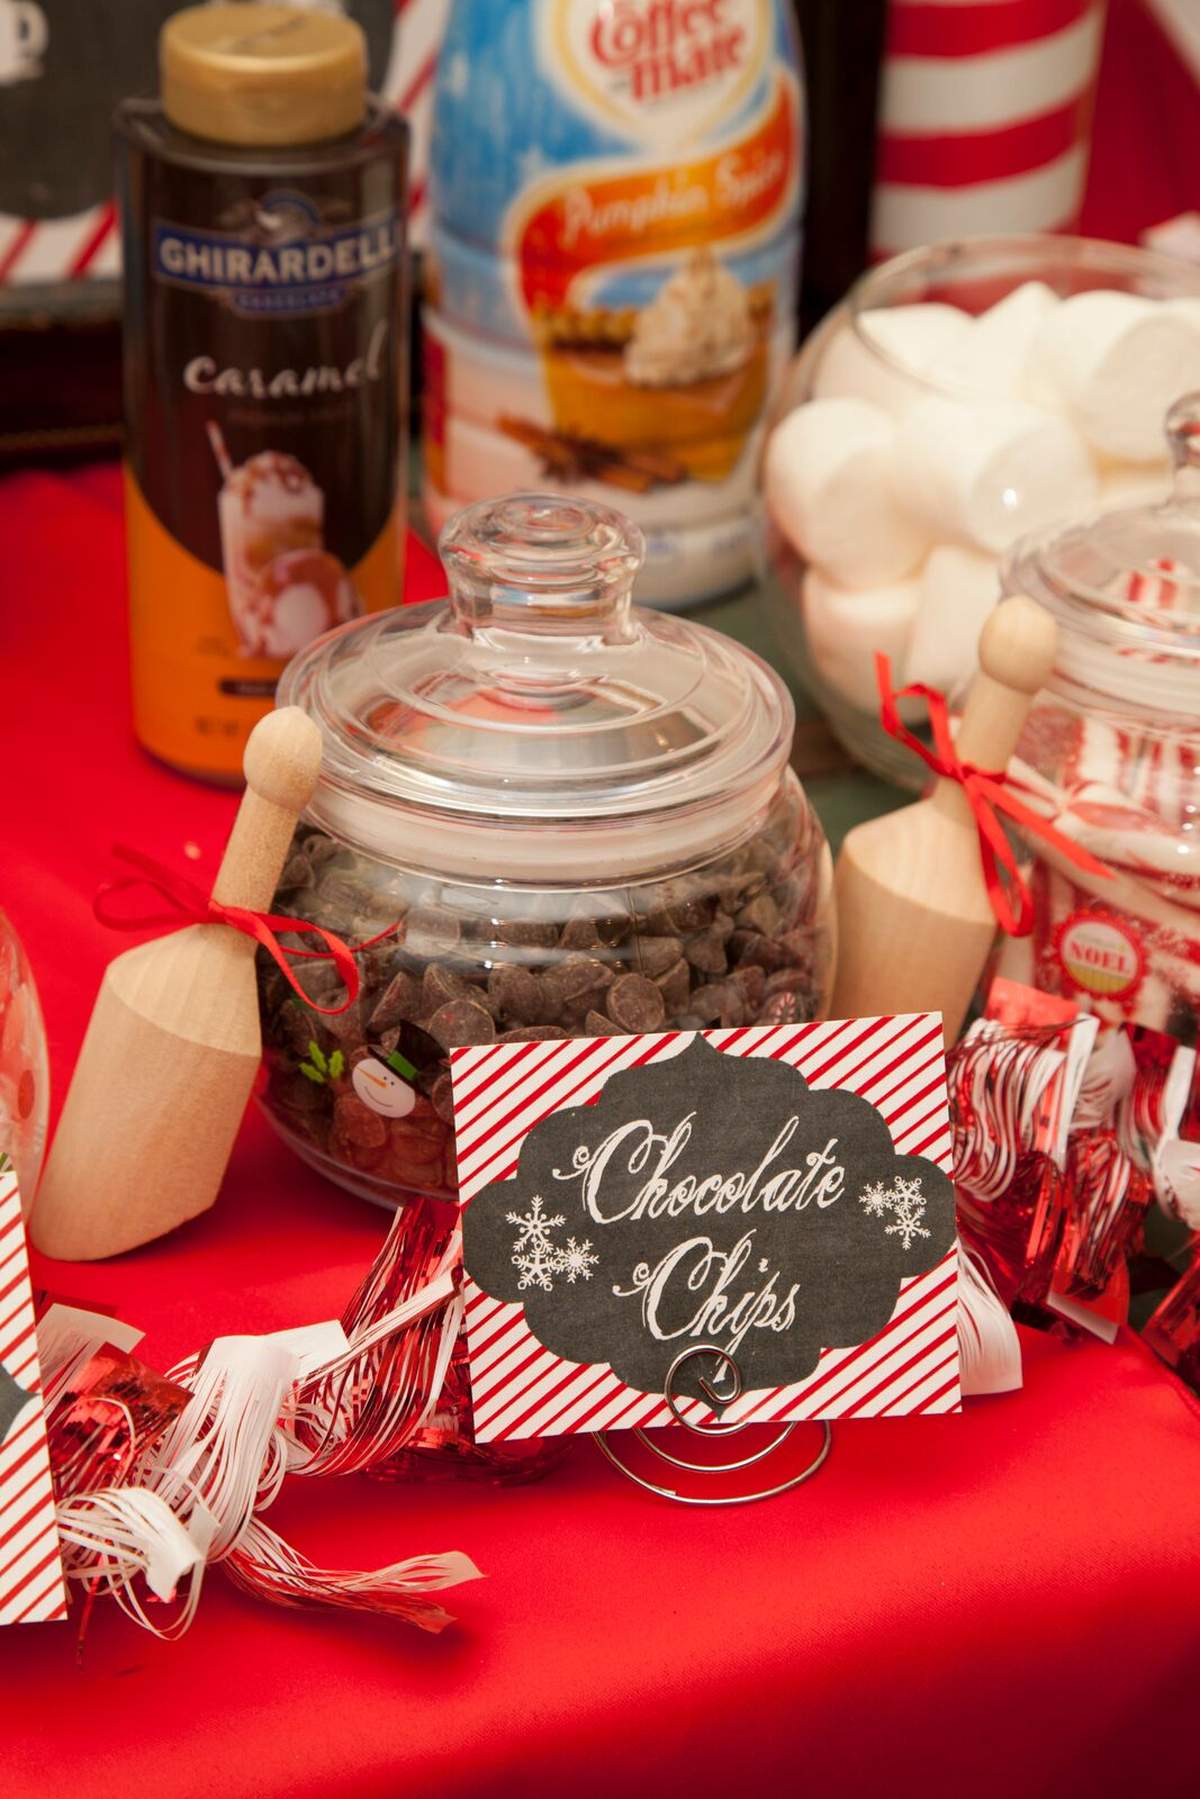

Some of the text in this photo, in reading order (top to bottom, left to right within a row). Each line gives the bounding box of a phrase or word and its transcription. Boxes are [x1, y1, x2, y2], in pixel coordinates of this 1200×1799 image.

[158, 224, 394, 284] GHIRARDELL
[183, 318, 388, 399] Caramel
[1070, 940, 1130, 974] NOEL
[552, 1111, 845, 1225] Chocolate
[612, 1228, 801, 1384] Chips
